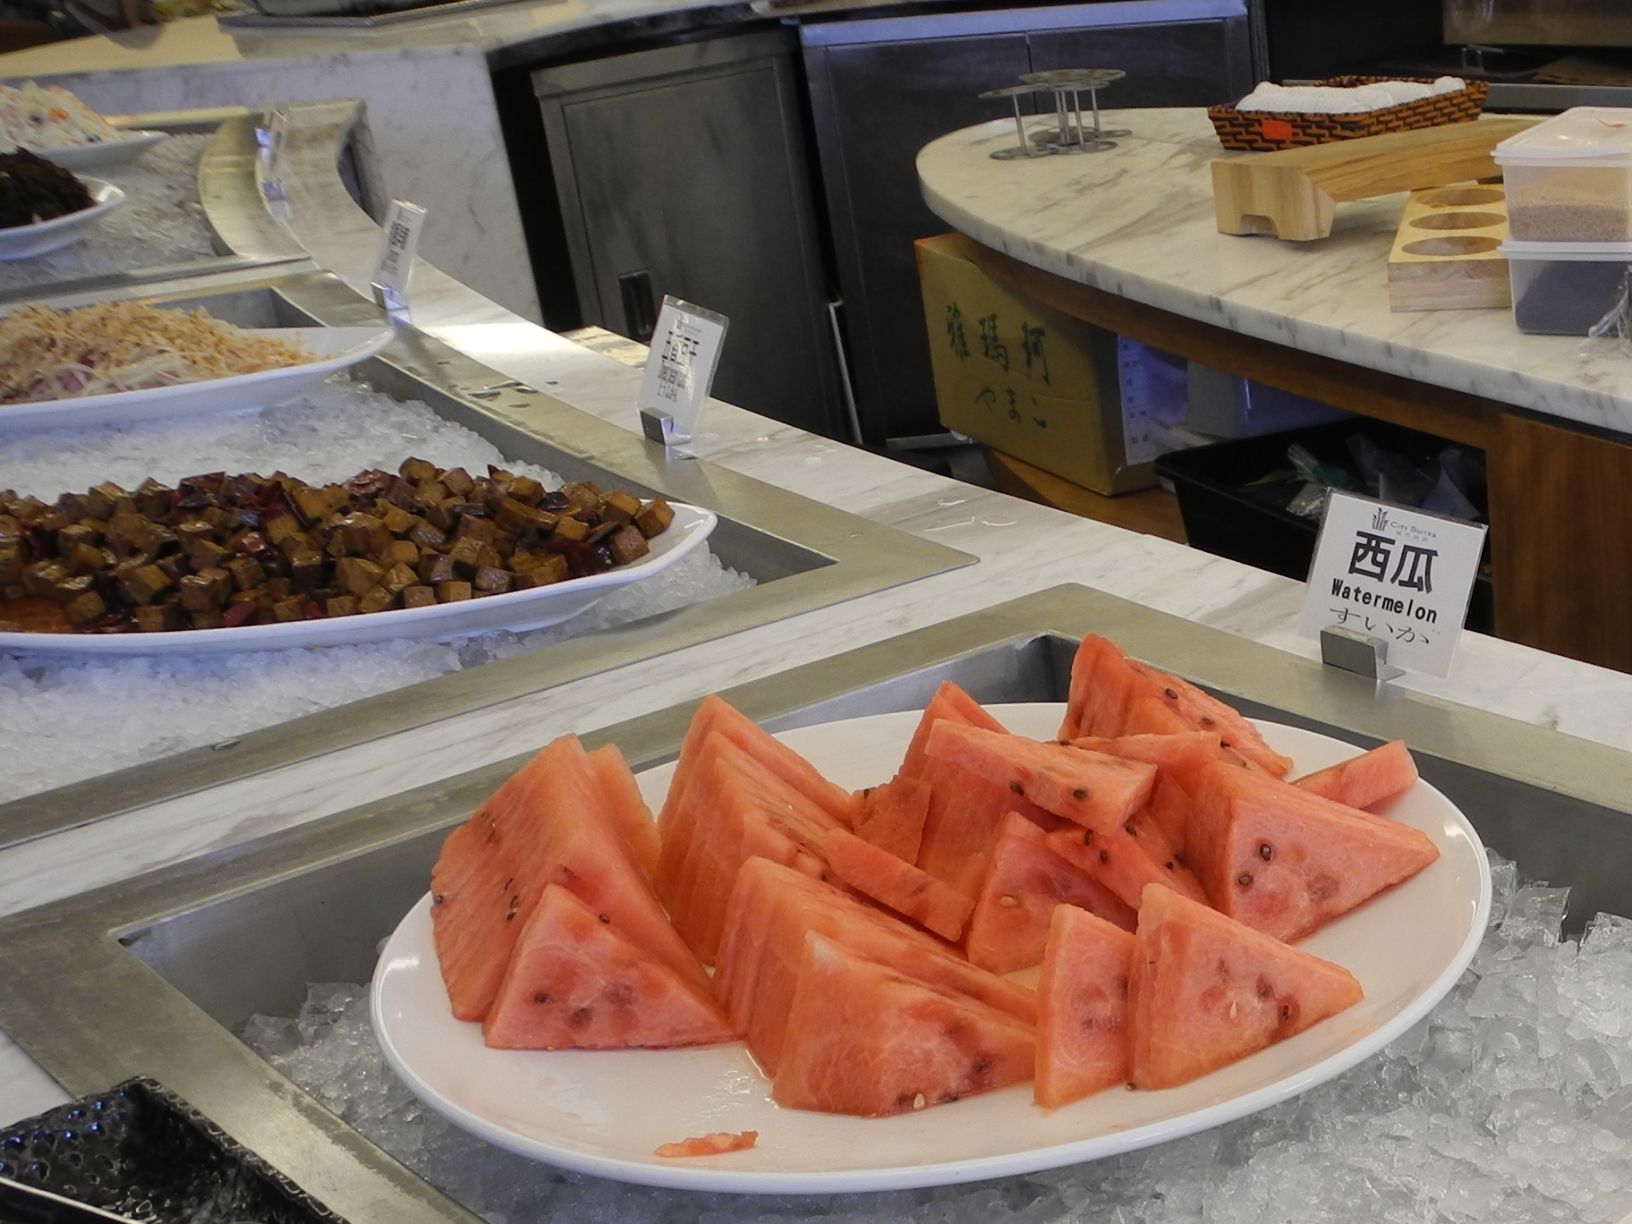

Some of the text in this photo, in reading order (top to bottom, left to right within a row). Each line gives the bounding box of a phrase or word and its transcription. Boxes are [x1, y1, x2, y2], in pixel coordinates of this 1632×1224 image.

[1347, 530, 1439, 595] 西瓜
[1331, 577, 1438, 624] Watermelon
[1328, 606, 1430, 645] すいか
